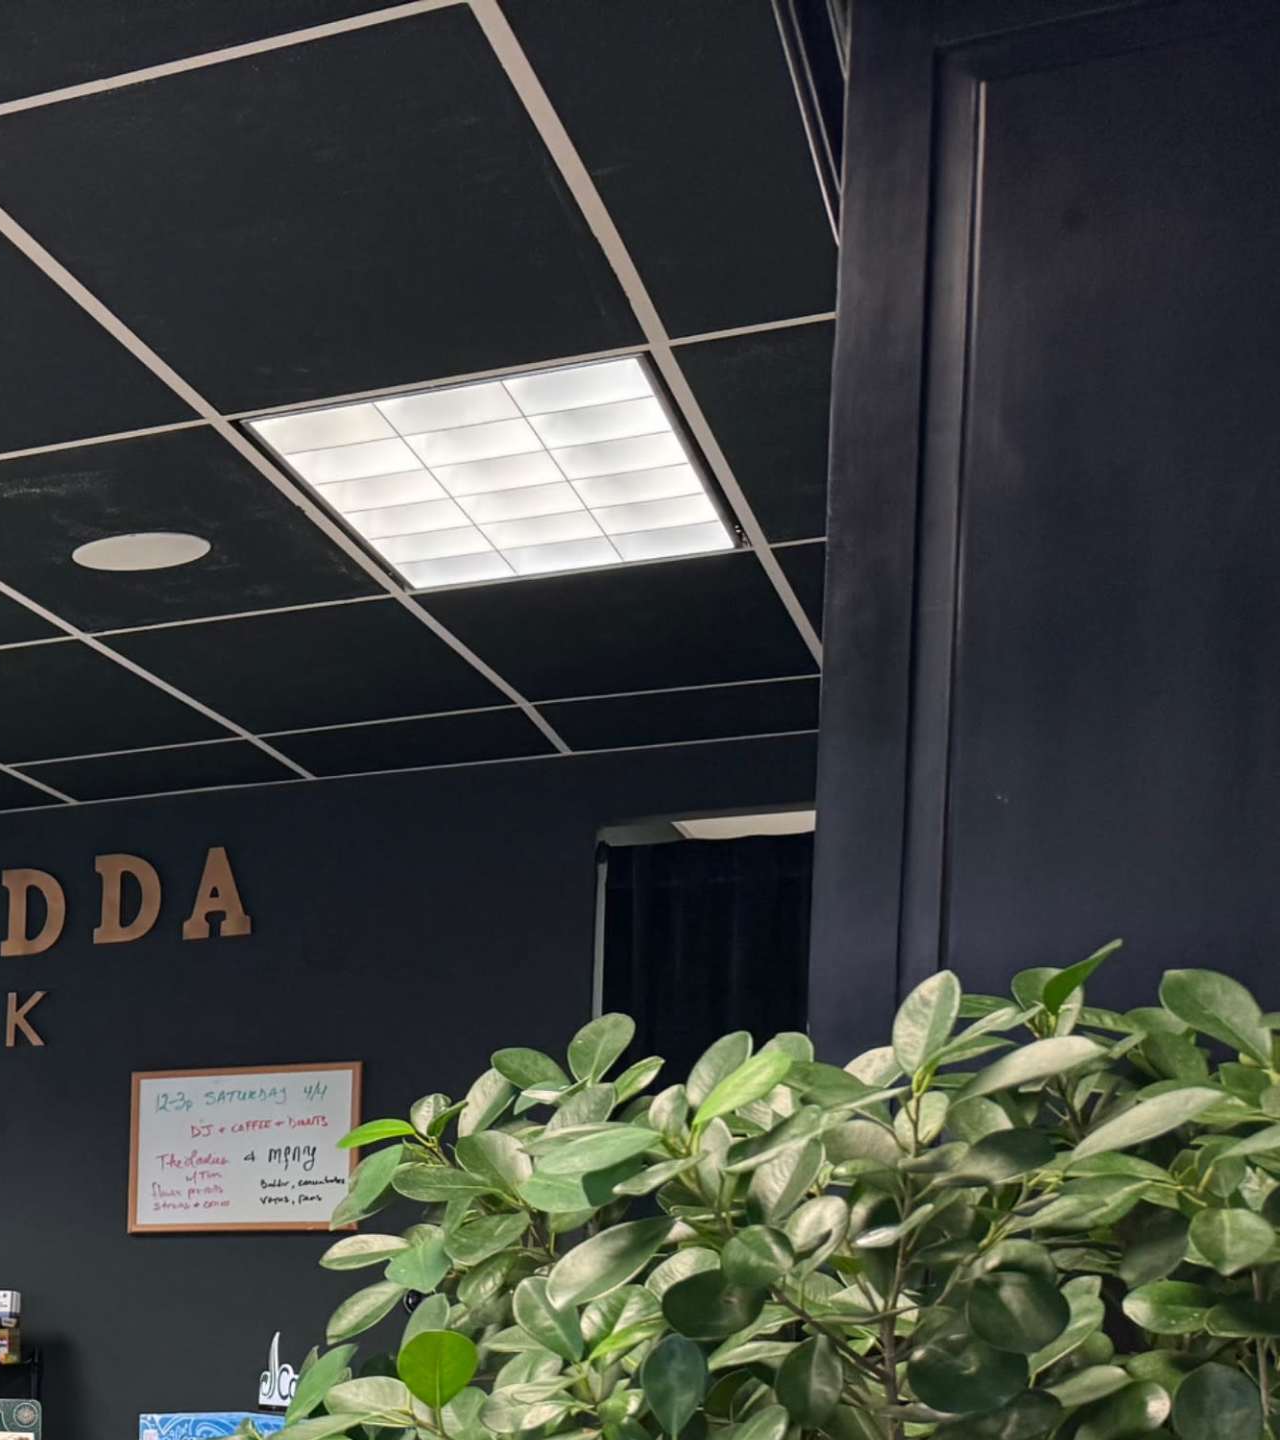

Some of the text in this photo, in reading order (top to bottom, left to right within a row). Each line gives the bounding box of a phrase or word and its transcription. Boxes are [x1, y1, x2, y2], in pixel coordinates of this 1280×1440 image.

[204, 1087, 289, 1106] SATURDAY
[191, 1124, 214, 1137] DJ
[231, 1119, 273, 1133] COFFEE
